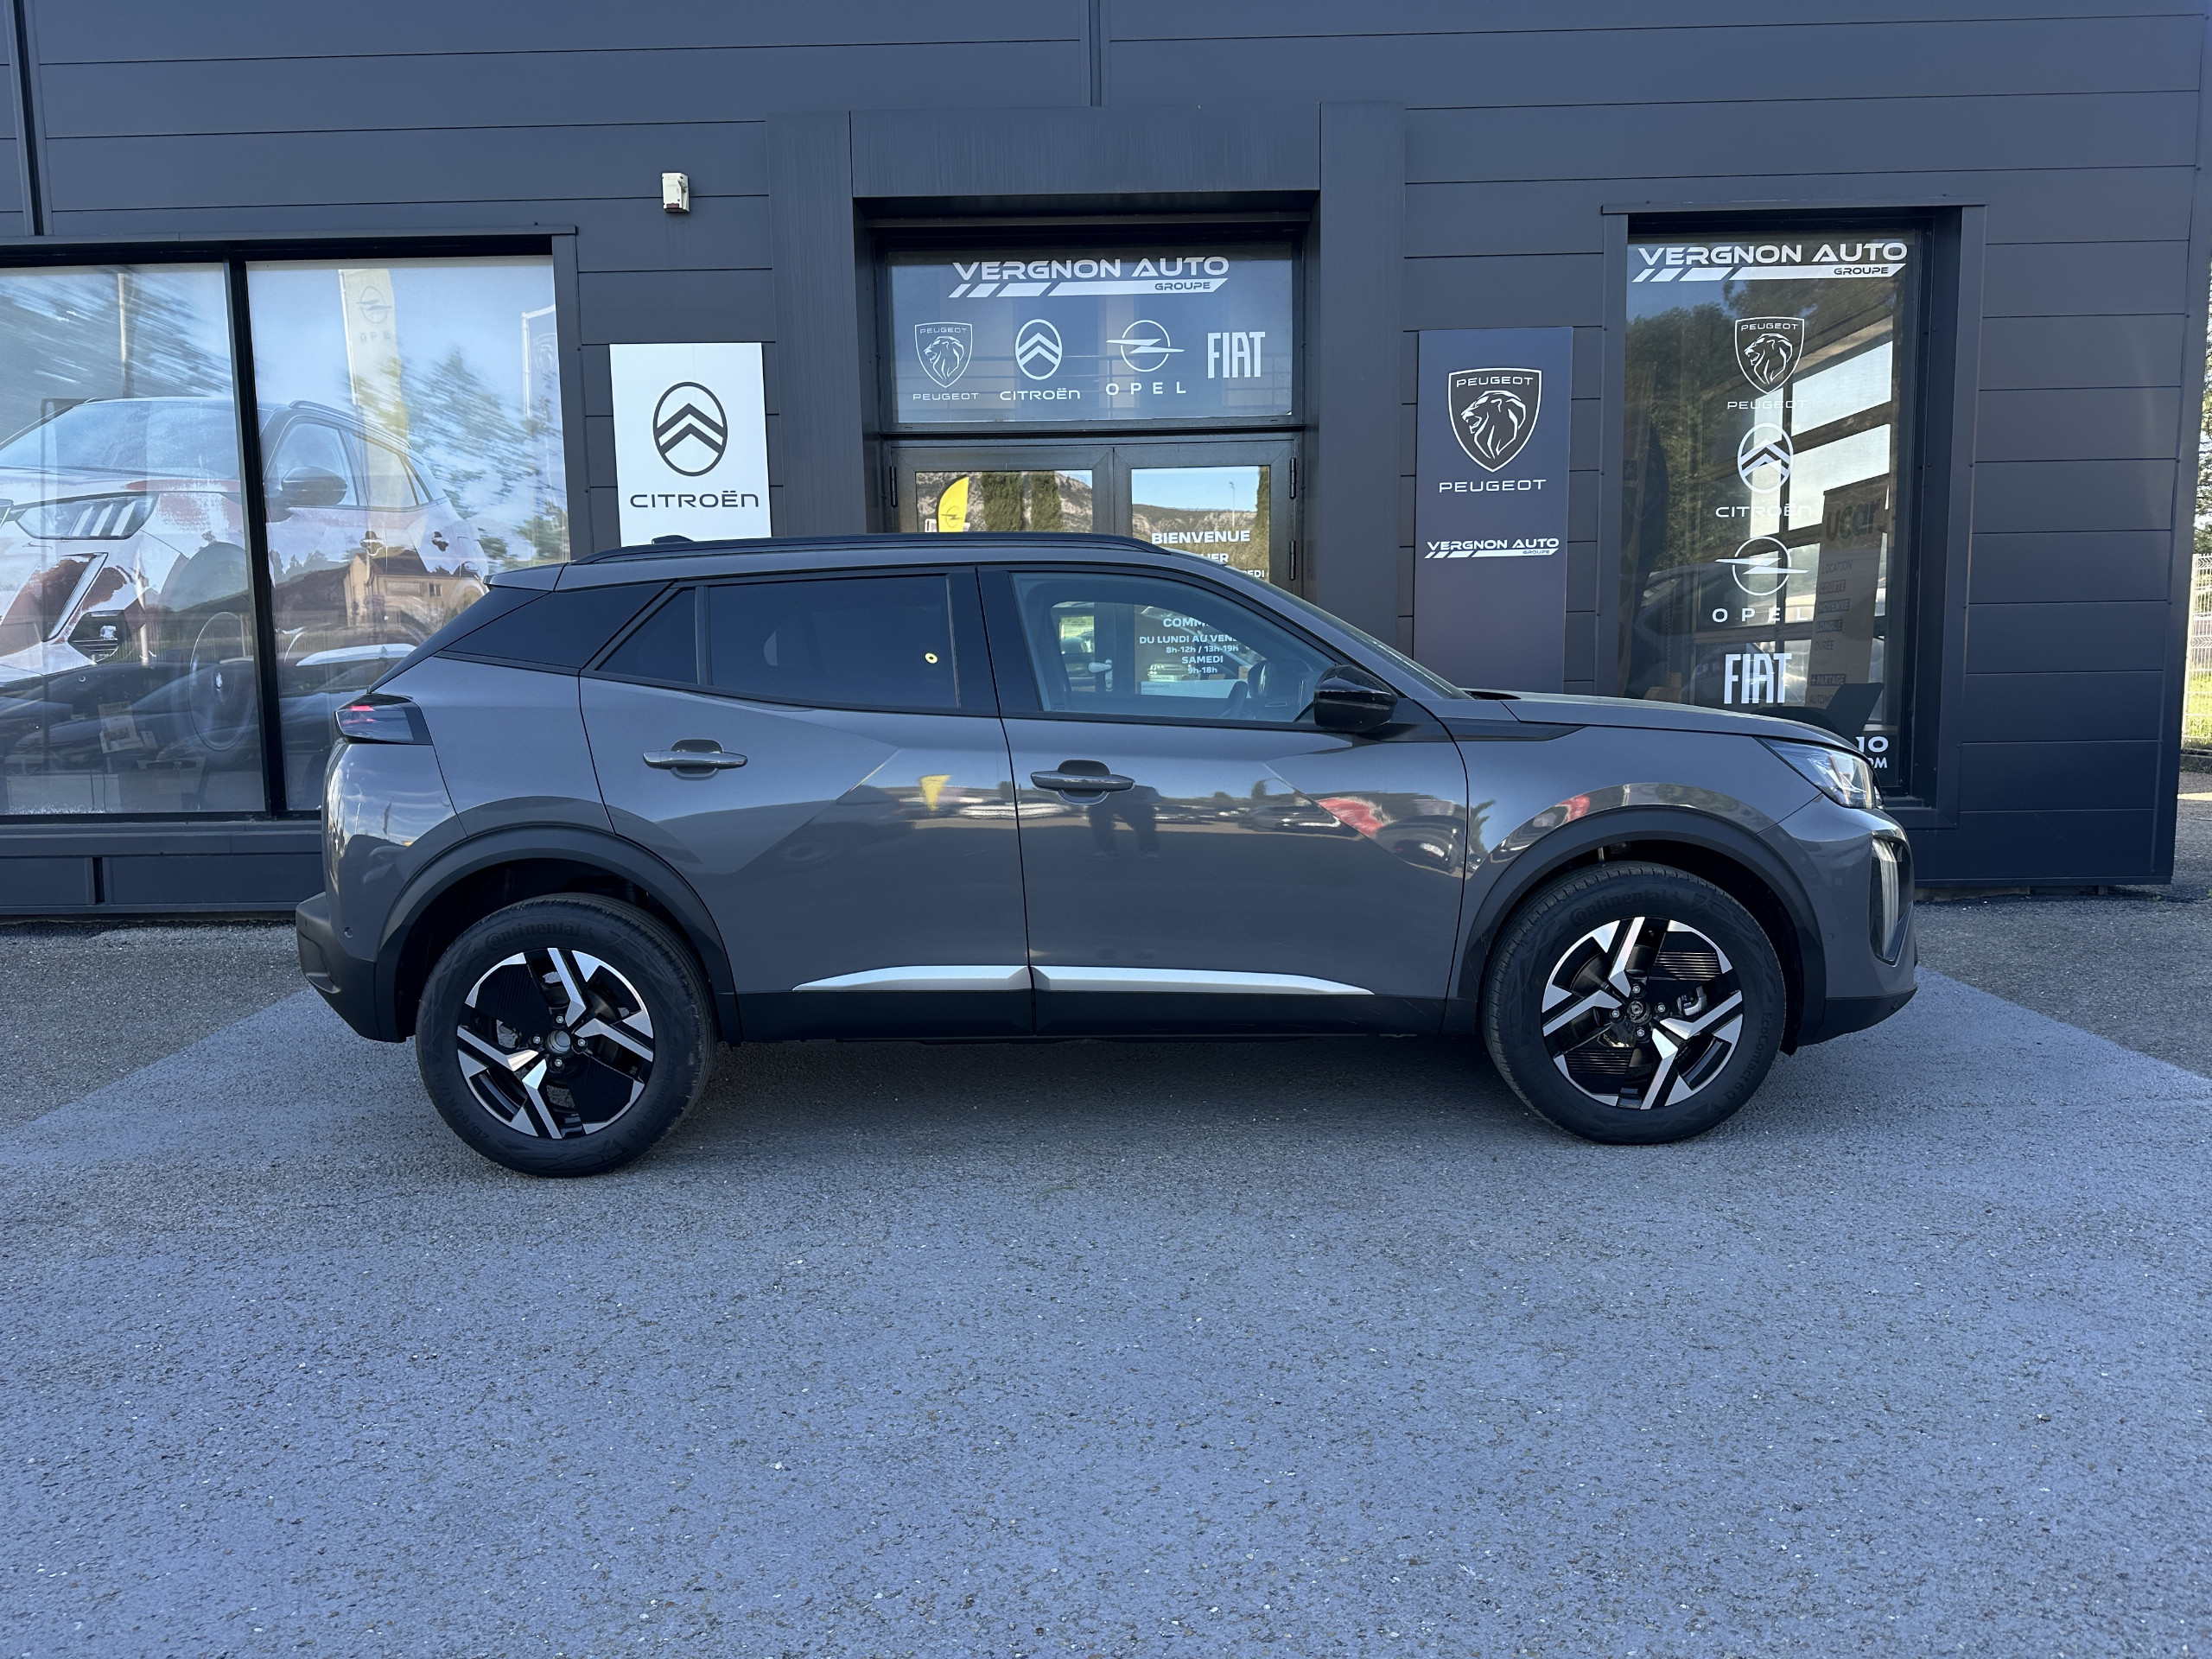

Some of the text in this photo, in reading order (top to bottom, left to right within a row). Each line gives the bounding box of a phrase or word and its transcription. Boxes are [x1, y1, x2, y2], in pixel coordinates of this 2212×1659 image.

[1638, 243, 1908, 265] VERGNON AUTO
[952, 257, 1230, 280] VERGNON AUTO
[1834, 266, 1889, 276] GROUPE
[1154, 281, 1211, 291] GROUPE
[919, 327, 968, 335] PEUGEOT
[1740, 322, 1799, 331] PEUGEOT
[1207, 331, 1266, 378] FIAT
[1105, 381, 1186, 396] OPEL
[1456, 376, 1534, 387] PEUGEOT
[912, 392, 979, 401] PEUGEOT
[1000, 387, 1081, 400] CITROËN
[1727, 399, 1808, 410] PEUGEOT
[1439, 479, 1547, 493] PEUGEOT
[630, 490, 760, 508] CITROËN
[1151, 530, 1250, 544] BIENVENUE
[1427, 537, 1560, 551] VERGNON AUTO
[1821, 560, 1853, 575] LOCATION
[1712, 607, 1808, 623] OPEL
[1816, 620, 1842, 632] LONGUE
[1157, 635, 1189, 644] LUNDI
[1724, 653, 1792, 704] FIAT
[1569, 888, 1667, 925] Continental
[485, 922, 582, 950] Continental
